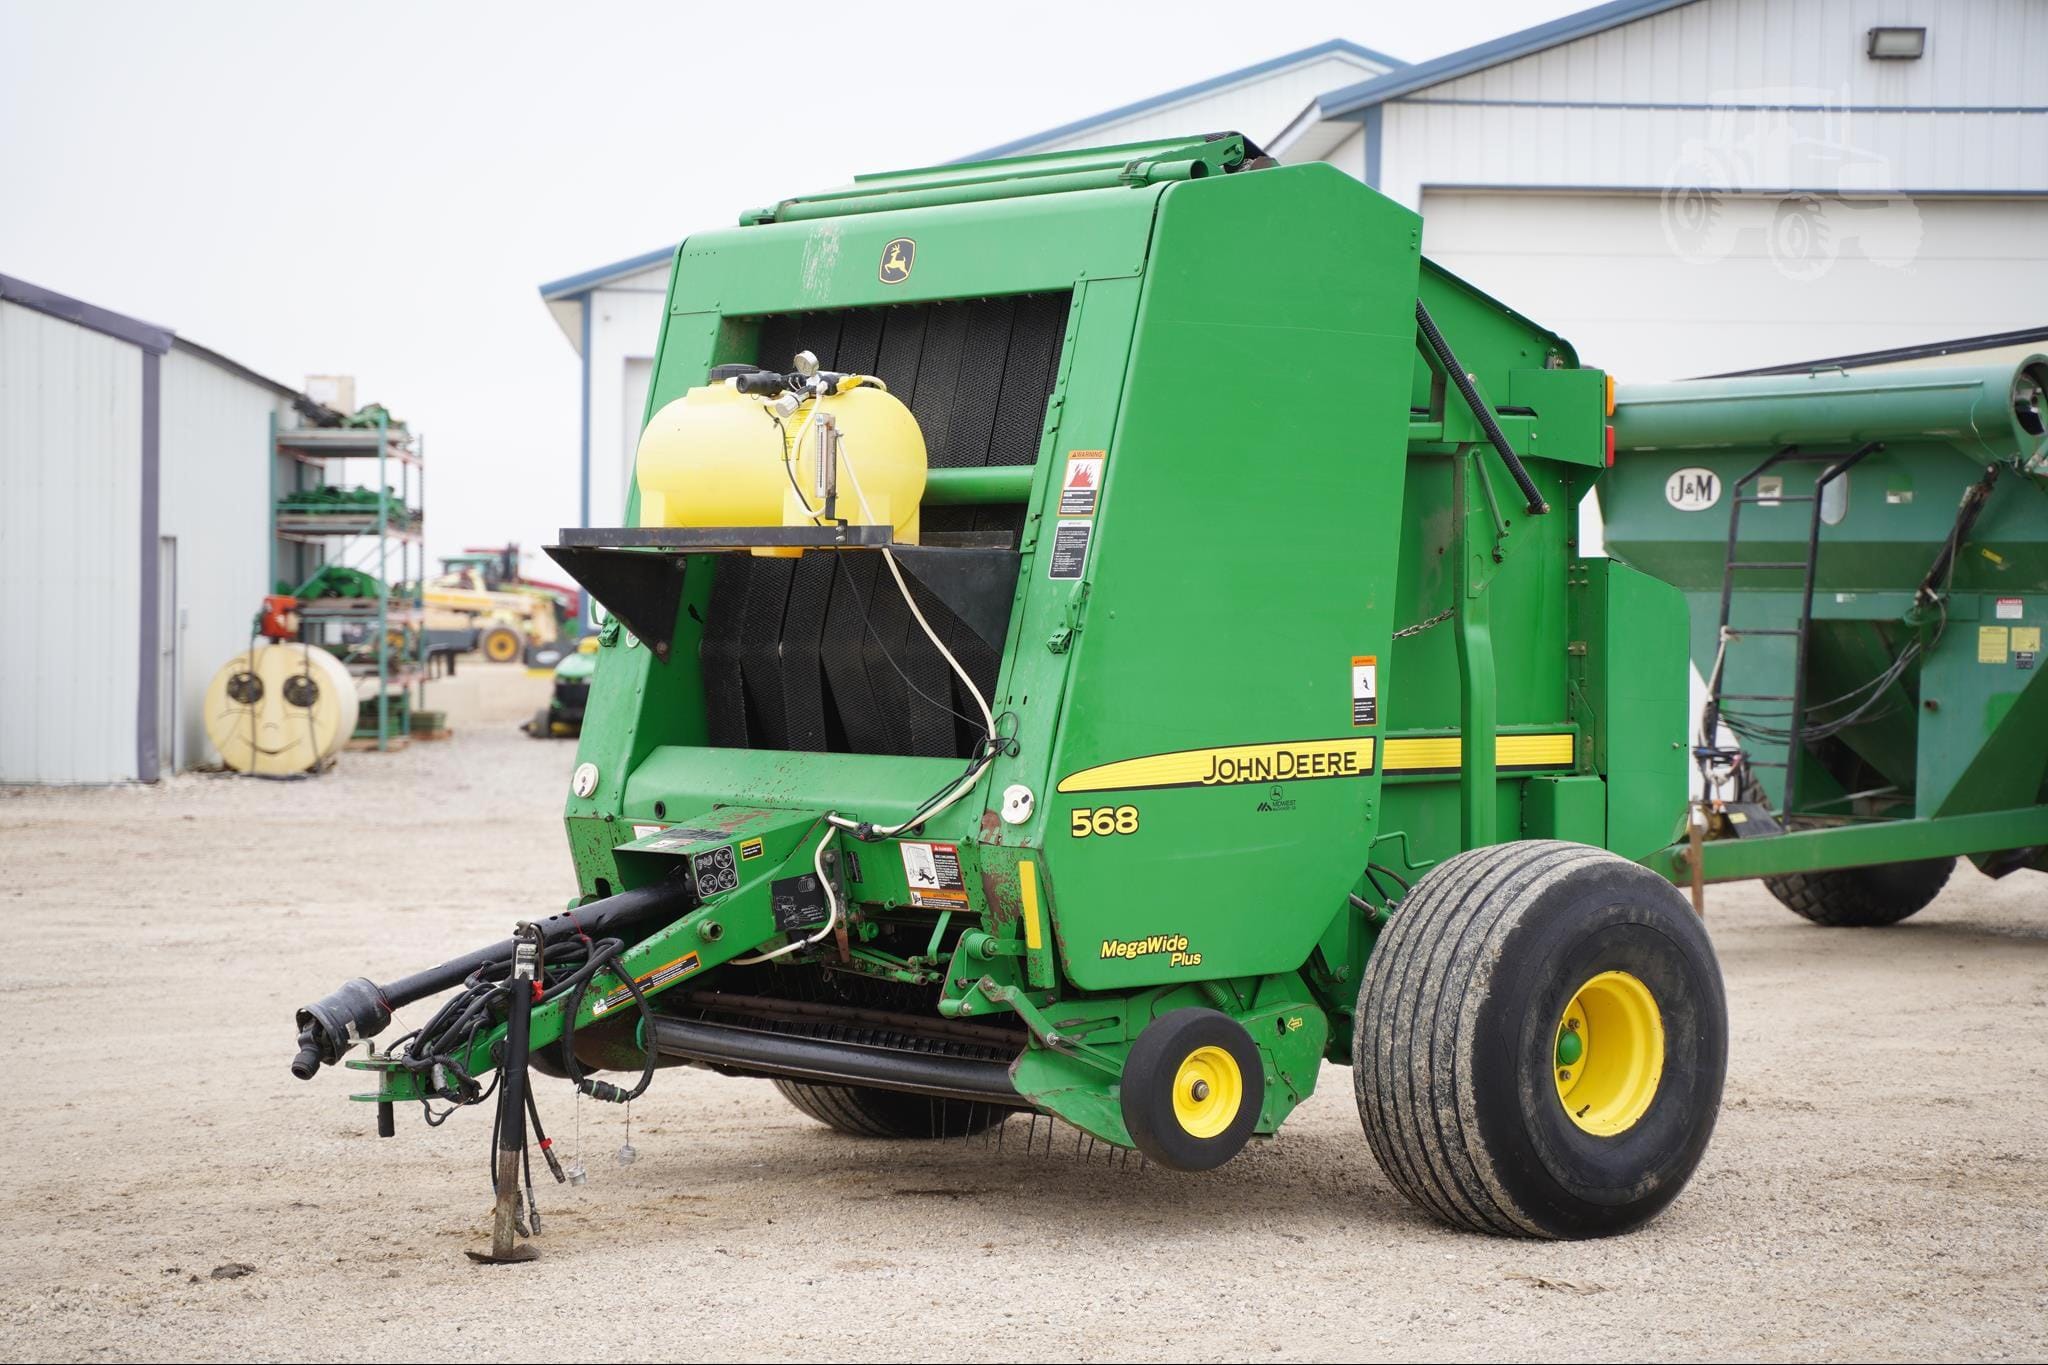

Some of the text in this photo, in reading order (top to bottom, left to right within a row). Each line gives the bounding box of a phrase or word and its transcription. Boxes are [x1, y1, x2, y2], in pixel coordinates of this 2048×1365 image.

[1671, 475, 1713, 502] J&M
[1203, 751, 1357, 781] JOHN DEERE
[1072, 805, 1139, 838] 568
[1100, 933, 1188, 960] MegaWide
[1170, 952, 1202, 968] Plus
